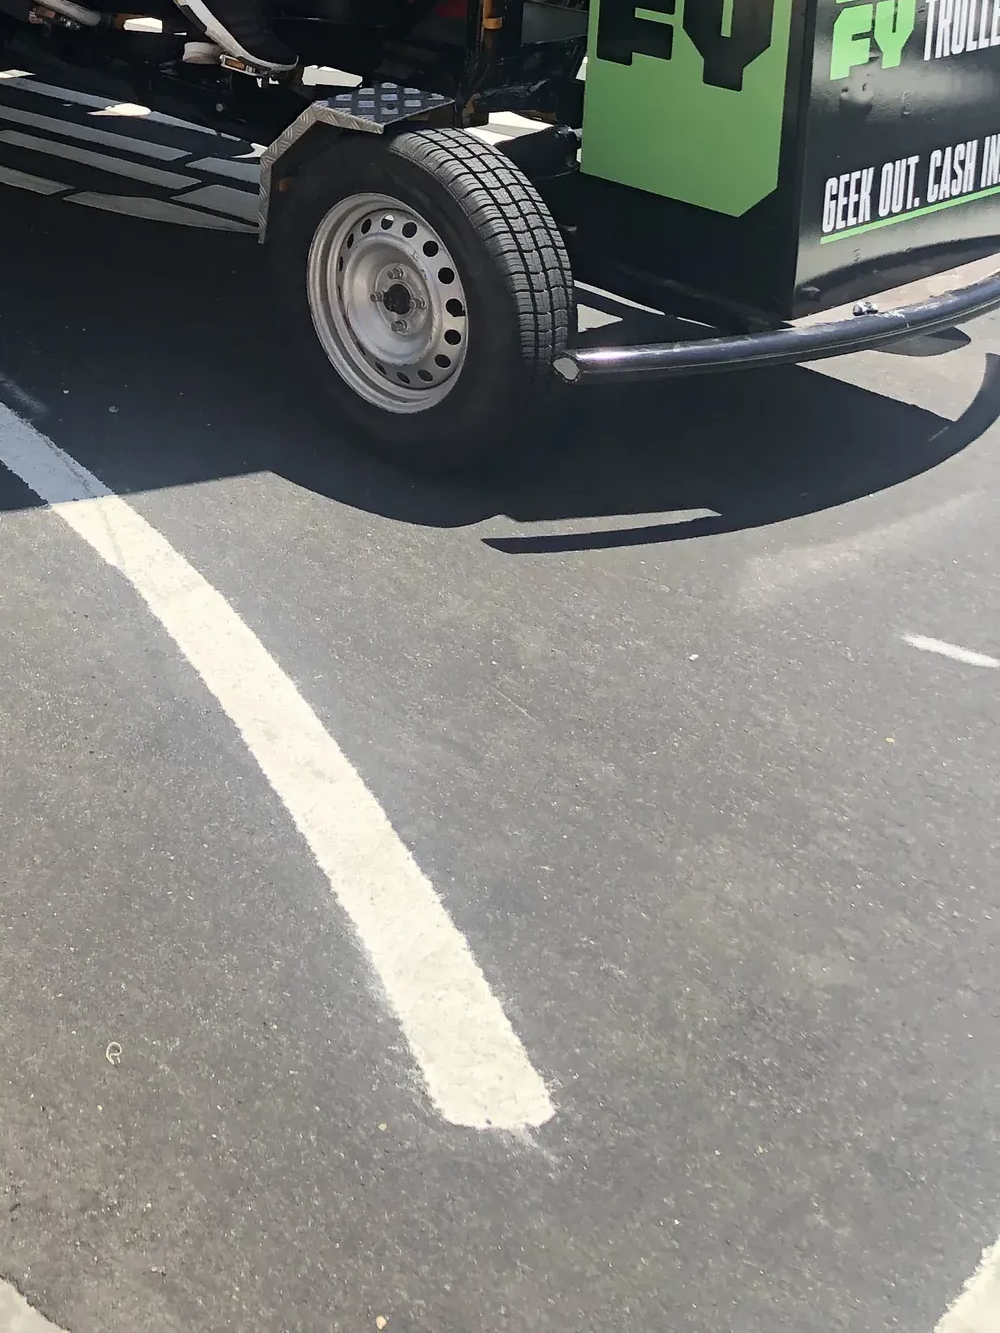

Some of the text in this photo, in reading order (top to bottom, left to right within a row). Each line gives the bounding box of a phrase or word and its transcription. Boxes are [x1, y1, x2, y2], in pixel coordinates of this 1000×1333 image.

[821, 166, 875, 234] GEEK
[878, 155, 920, 218] OUT.
[926, 139, 978, 204] CASH
